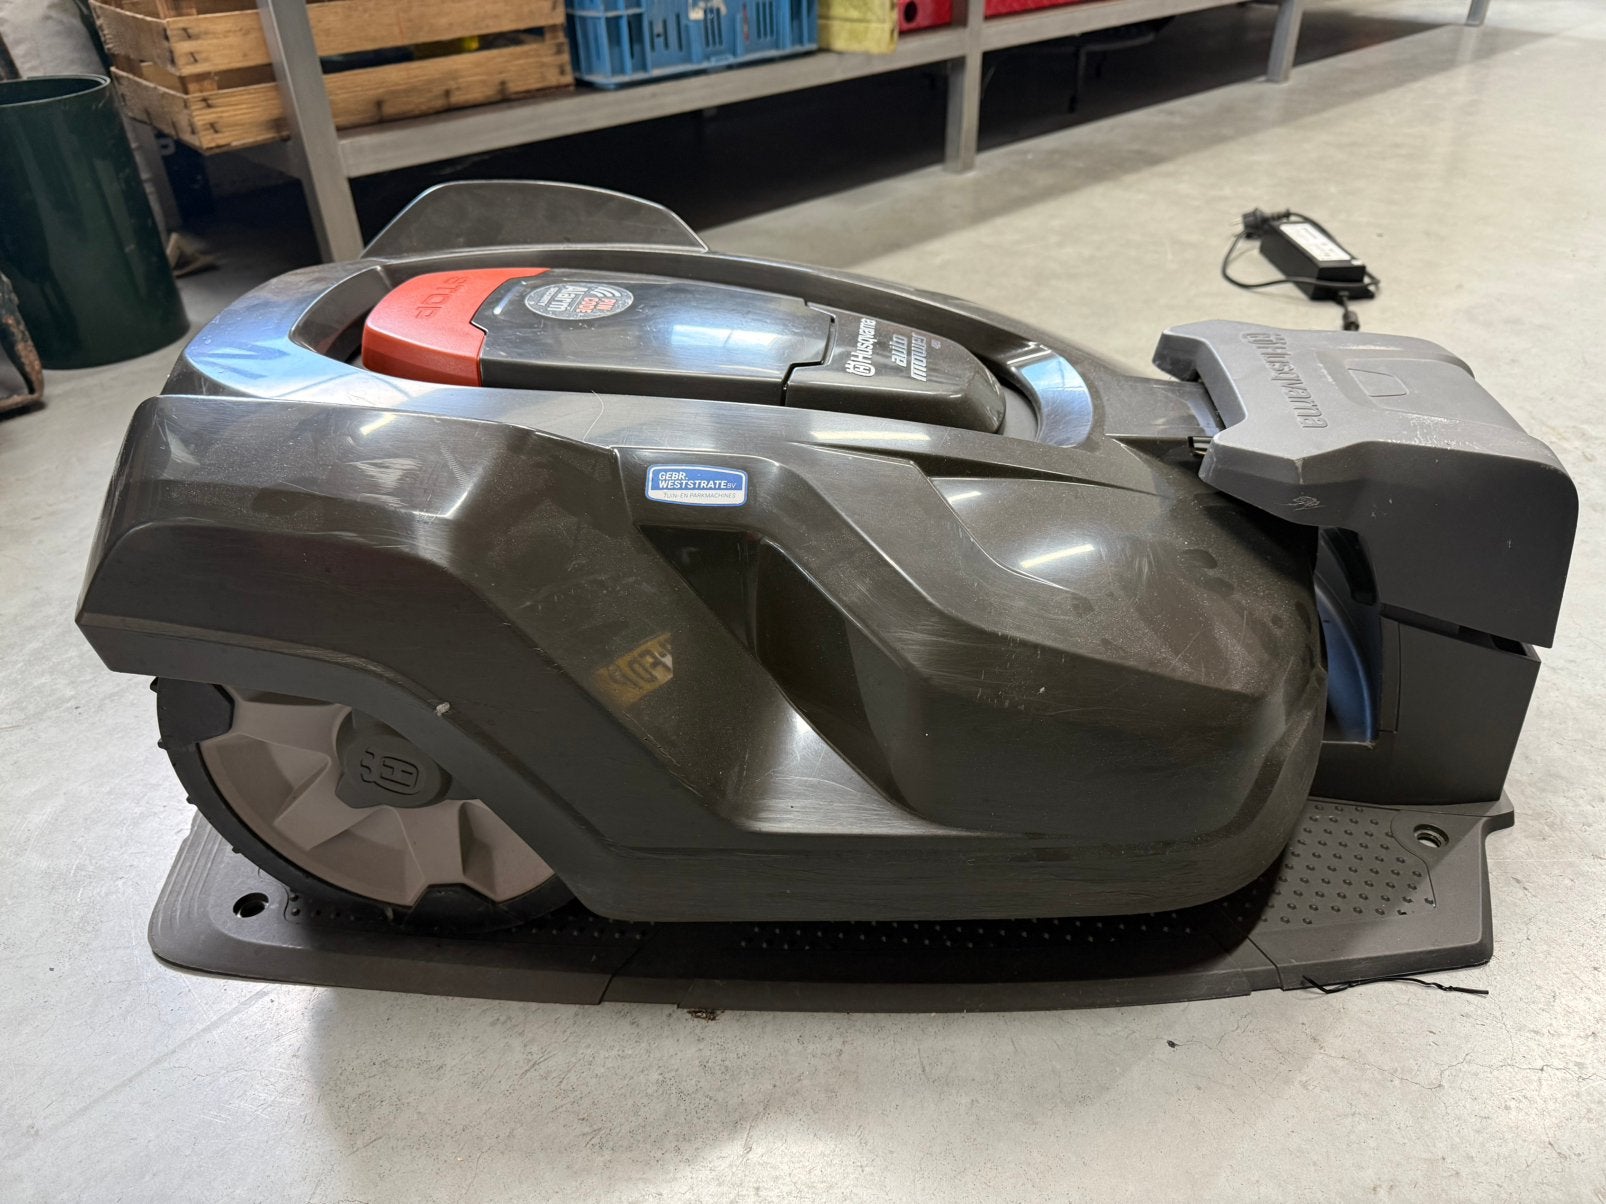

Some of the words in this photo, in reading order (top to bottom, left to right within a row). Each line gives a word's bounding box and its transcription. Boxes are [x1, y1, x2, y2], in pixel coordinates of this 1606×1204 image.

[414, 276, 468, 319] STOP
[547, 285, 588, 311] Alarm
[576, 297, 600, 313] CODE
[850, 318, 877, 363] Husqvarna
[889, 334, 908, 367] auto
[911, 332, 927, 381] mower
[1254, 345, 1329, 429] Husqvarna
[658, 471, 688, 480] GEBR.
[658, 480, 727, 489] WESTSTRATE
